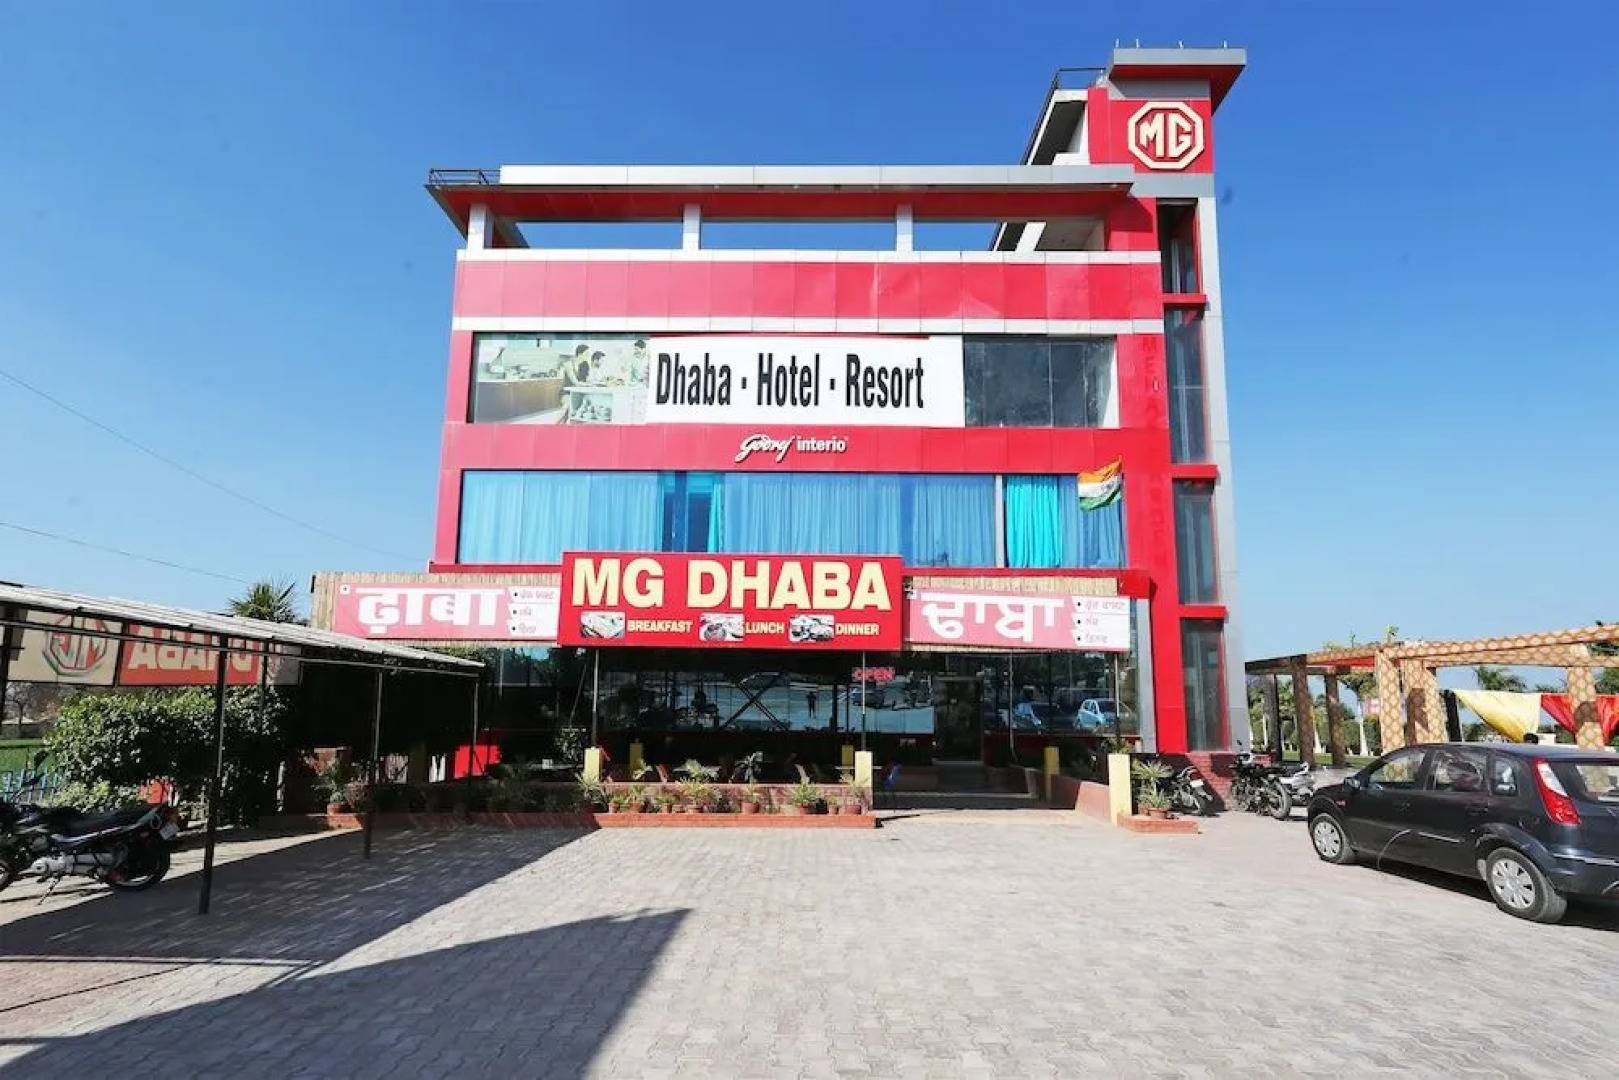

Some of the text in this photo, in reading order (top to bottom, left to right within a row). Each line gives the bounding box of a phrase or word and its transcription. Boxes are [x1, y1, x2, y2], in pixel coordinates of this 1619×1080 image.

[655, 352, 924, 409] Dhaba Hotel Resort
[796, 435, 848, 454] interio
[572, 557, 893, 610] MG DHABA
[627, 619, 880, 636] BREAKFAST LUNCH DINNER
[854, 667, 894, 681] OPEN
